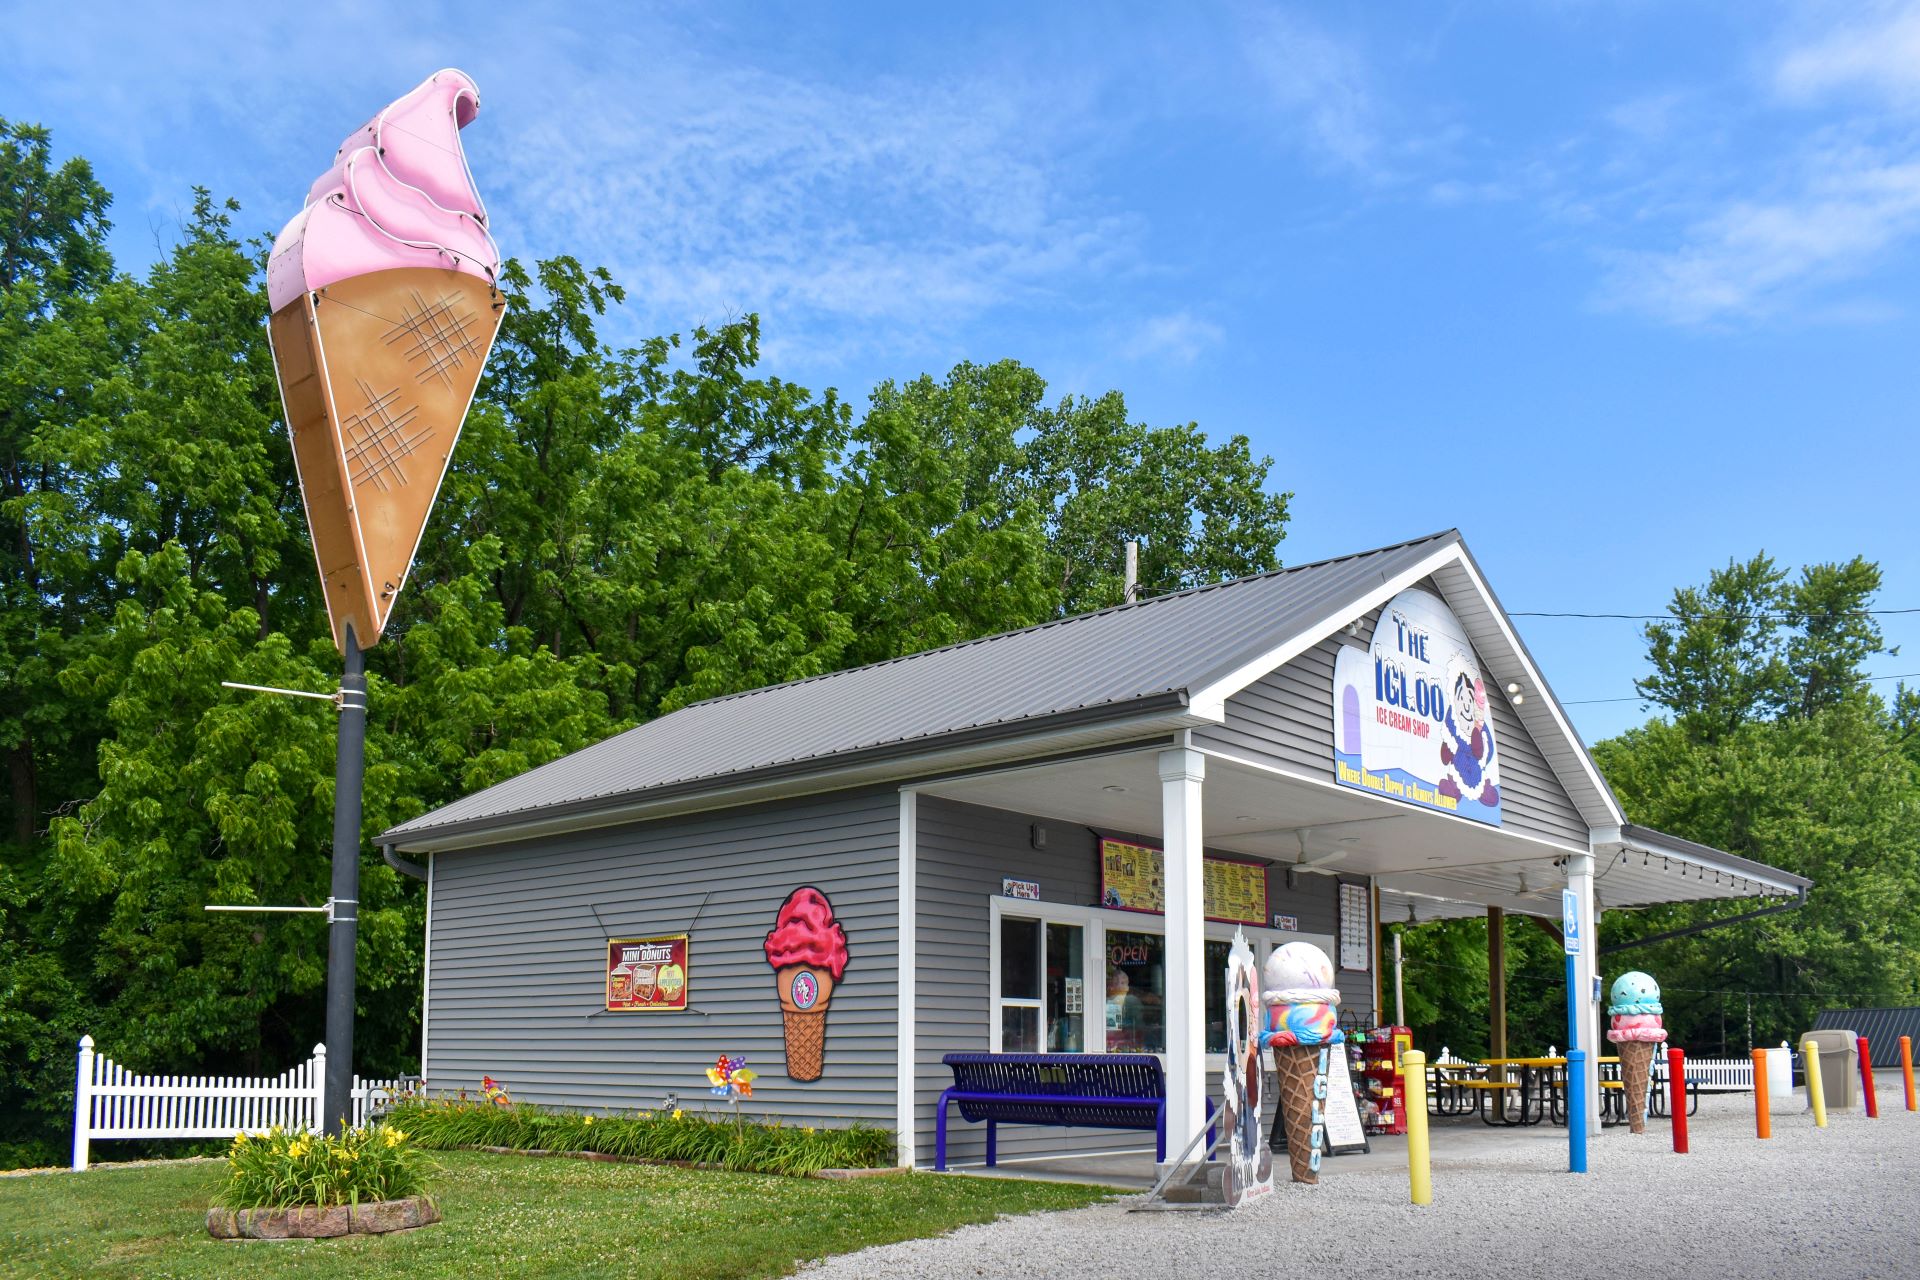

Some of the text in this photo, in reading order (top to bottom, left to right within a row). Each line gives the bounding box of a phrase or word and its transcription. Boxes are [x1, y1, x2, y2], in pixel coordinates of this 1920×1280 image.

[1392, 610, 1430, 664] THE
[1375, 642, 1444, 722] IGLOO
[1376, 705, 1430, 740] ICE CREAM SHOP
[1012, 881, 1034, 893] Pick Up
[1016, 889, 1030, 898] Here
[622, 950, 640, 962] MINI
[641, 948, 671, 961] DONUTS
[1111, 943, 1148, 965] OPEN
[1310, 1048, 1328, 1173] IGLOO
